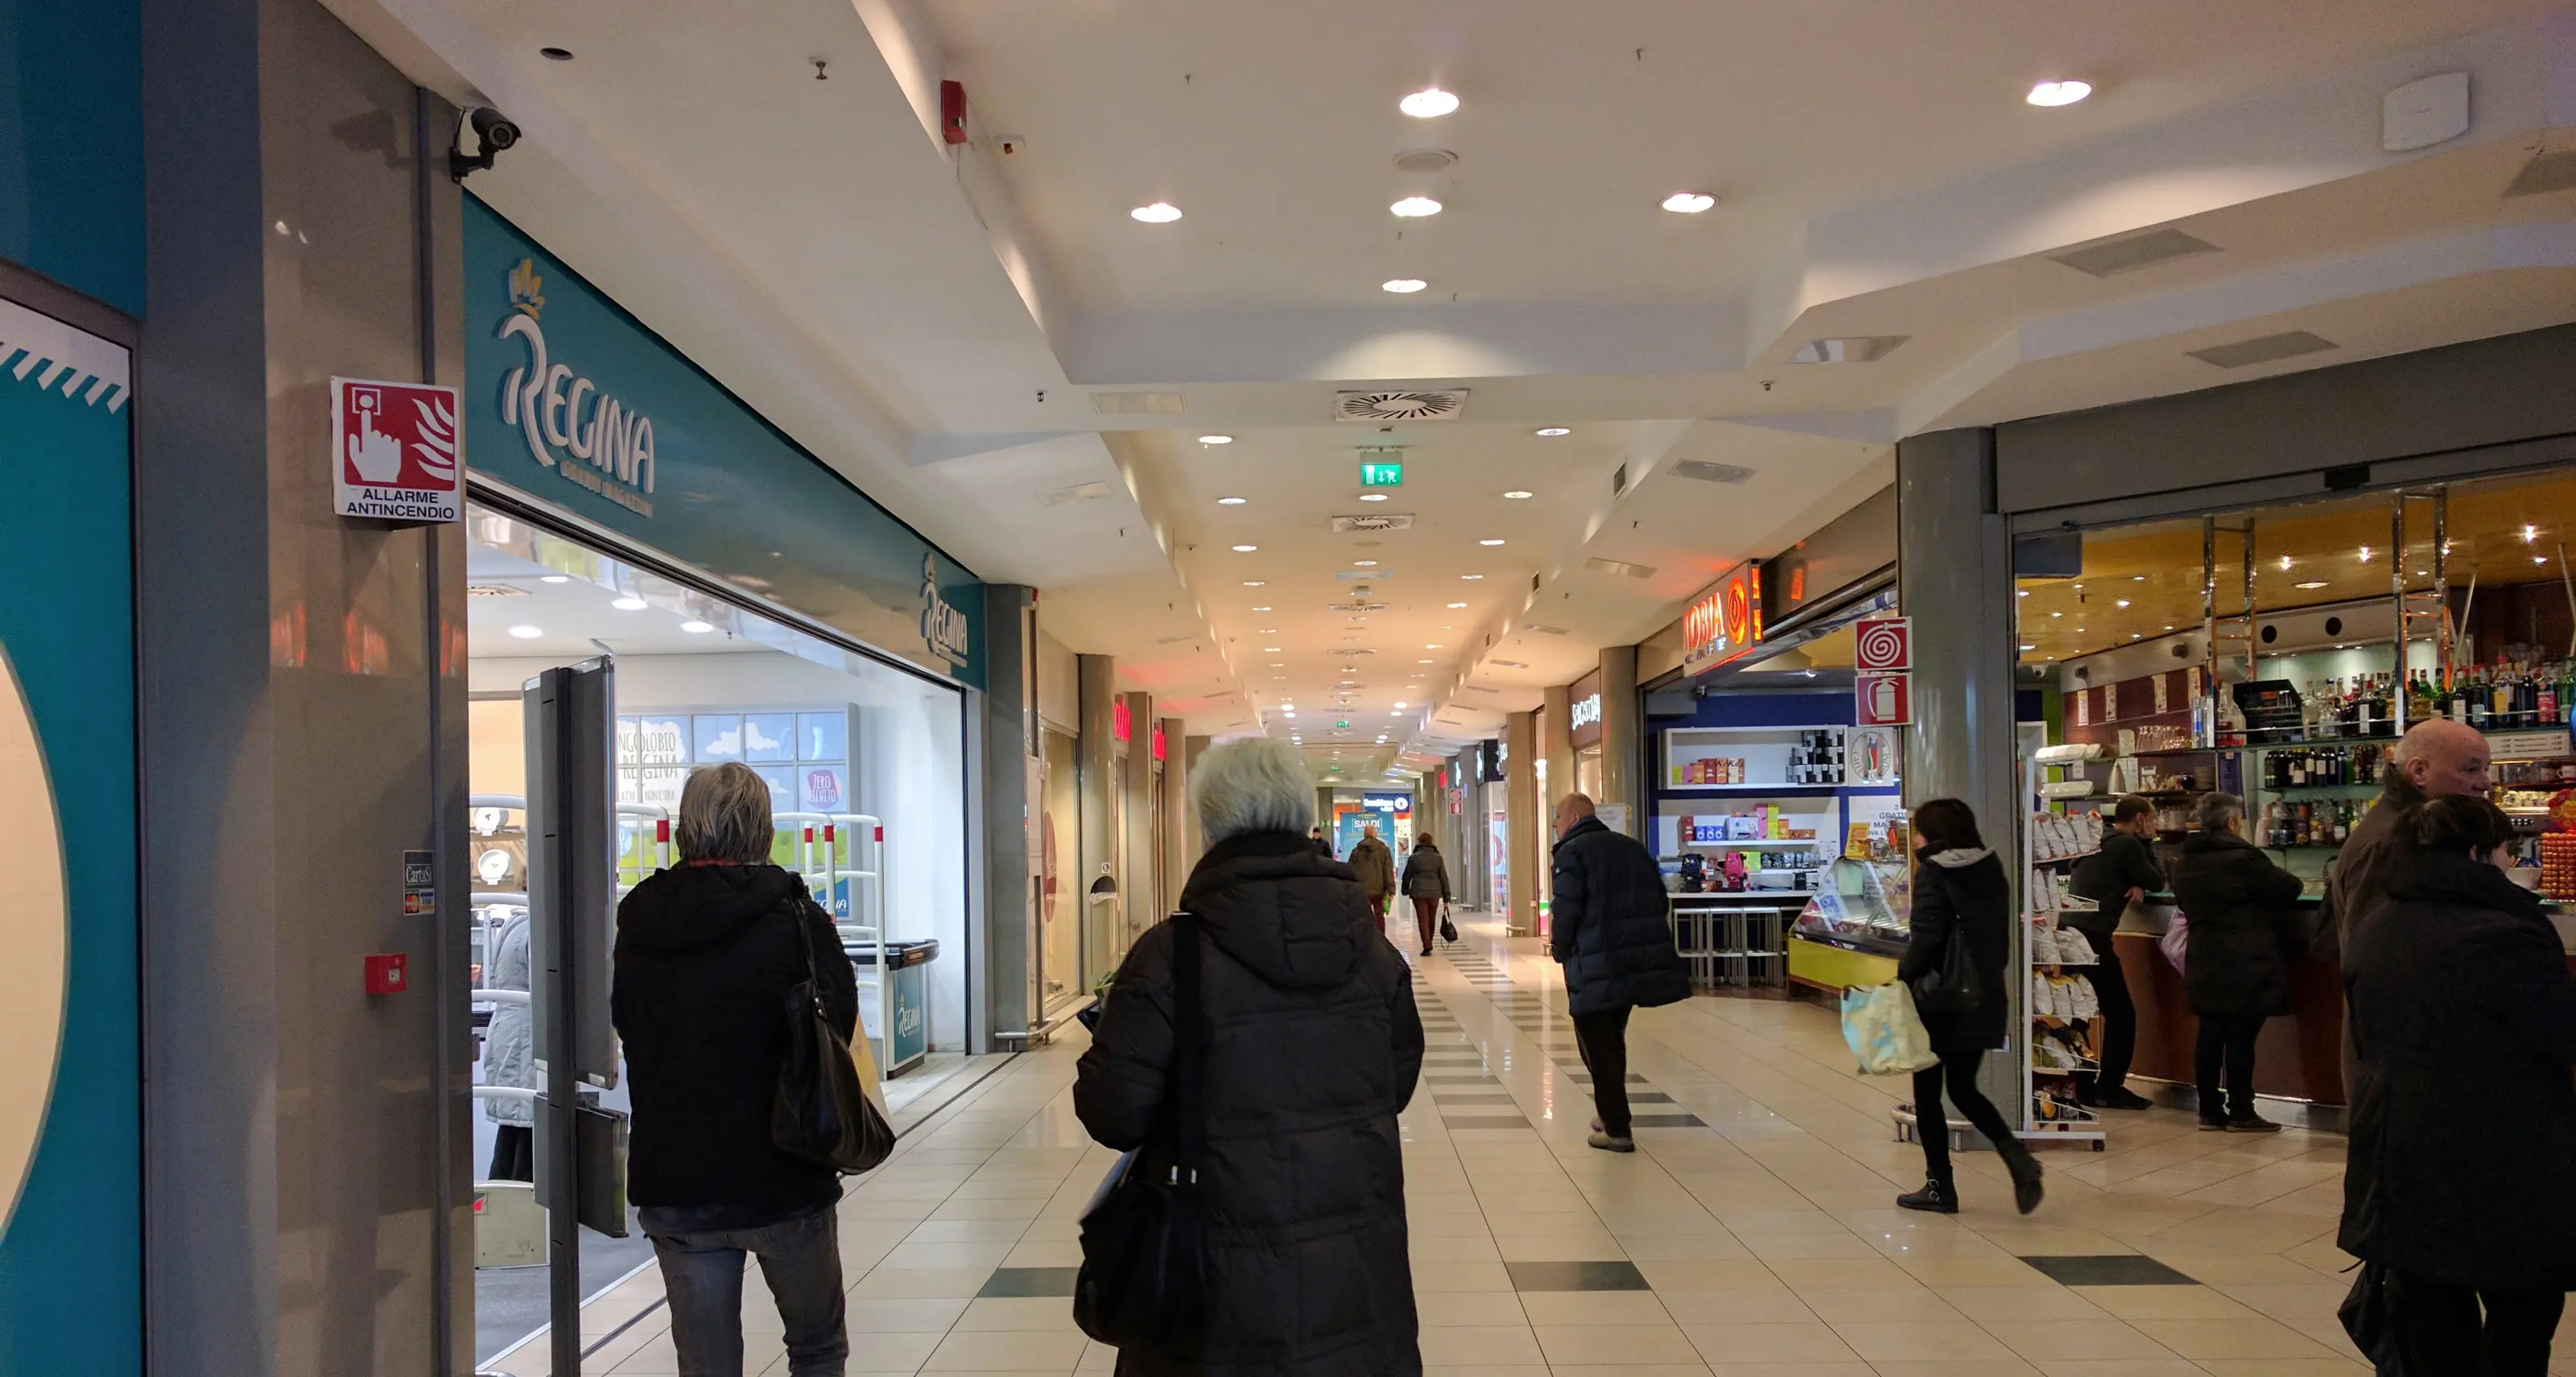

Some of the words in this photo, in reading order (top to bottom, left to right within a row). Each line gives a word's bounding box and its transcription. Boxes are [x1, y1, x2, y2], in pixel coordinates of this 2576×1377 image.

[498, 313, 654, 493] REGINA
[362, 489, 439, 504] ALLARME
[346, 501, 455, 519] ANTINCENDIO
[923, 581, 968, 655] REGINA
[812, 773, 831, 790] ZERO
